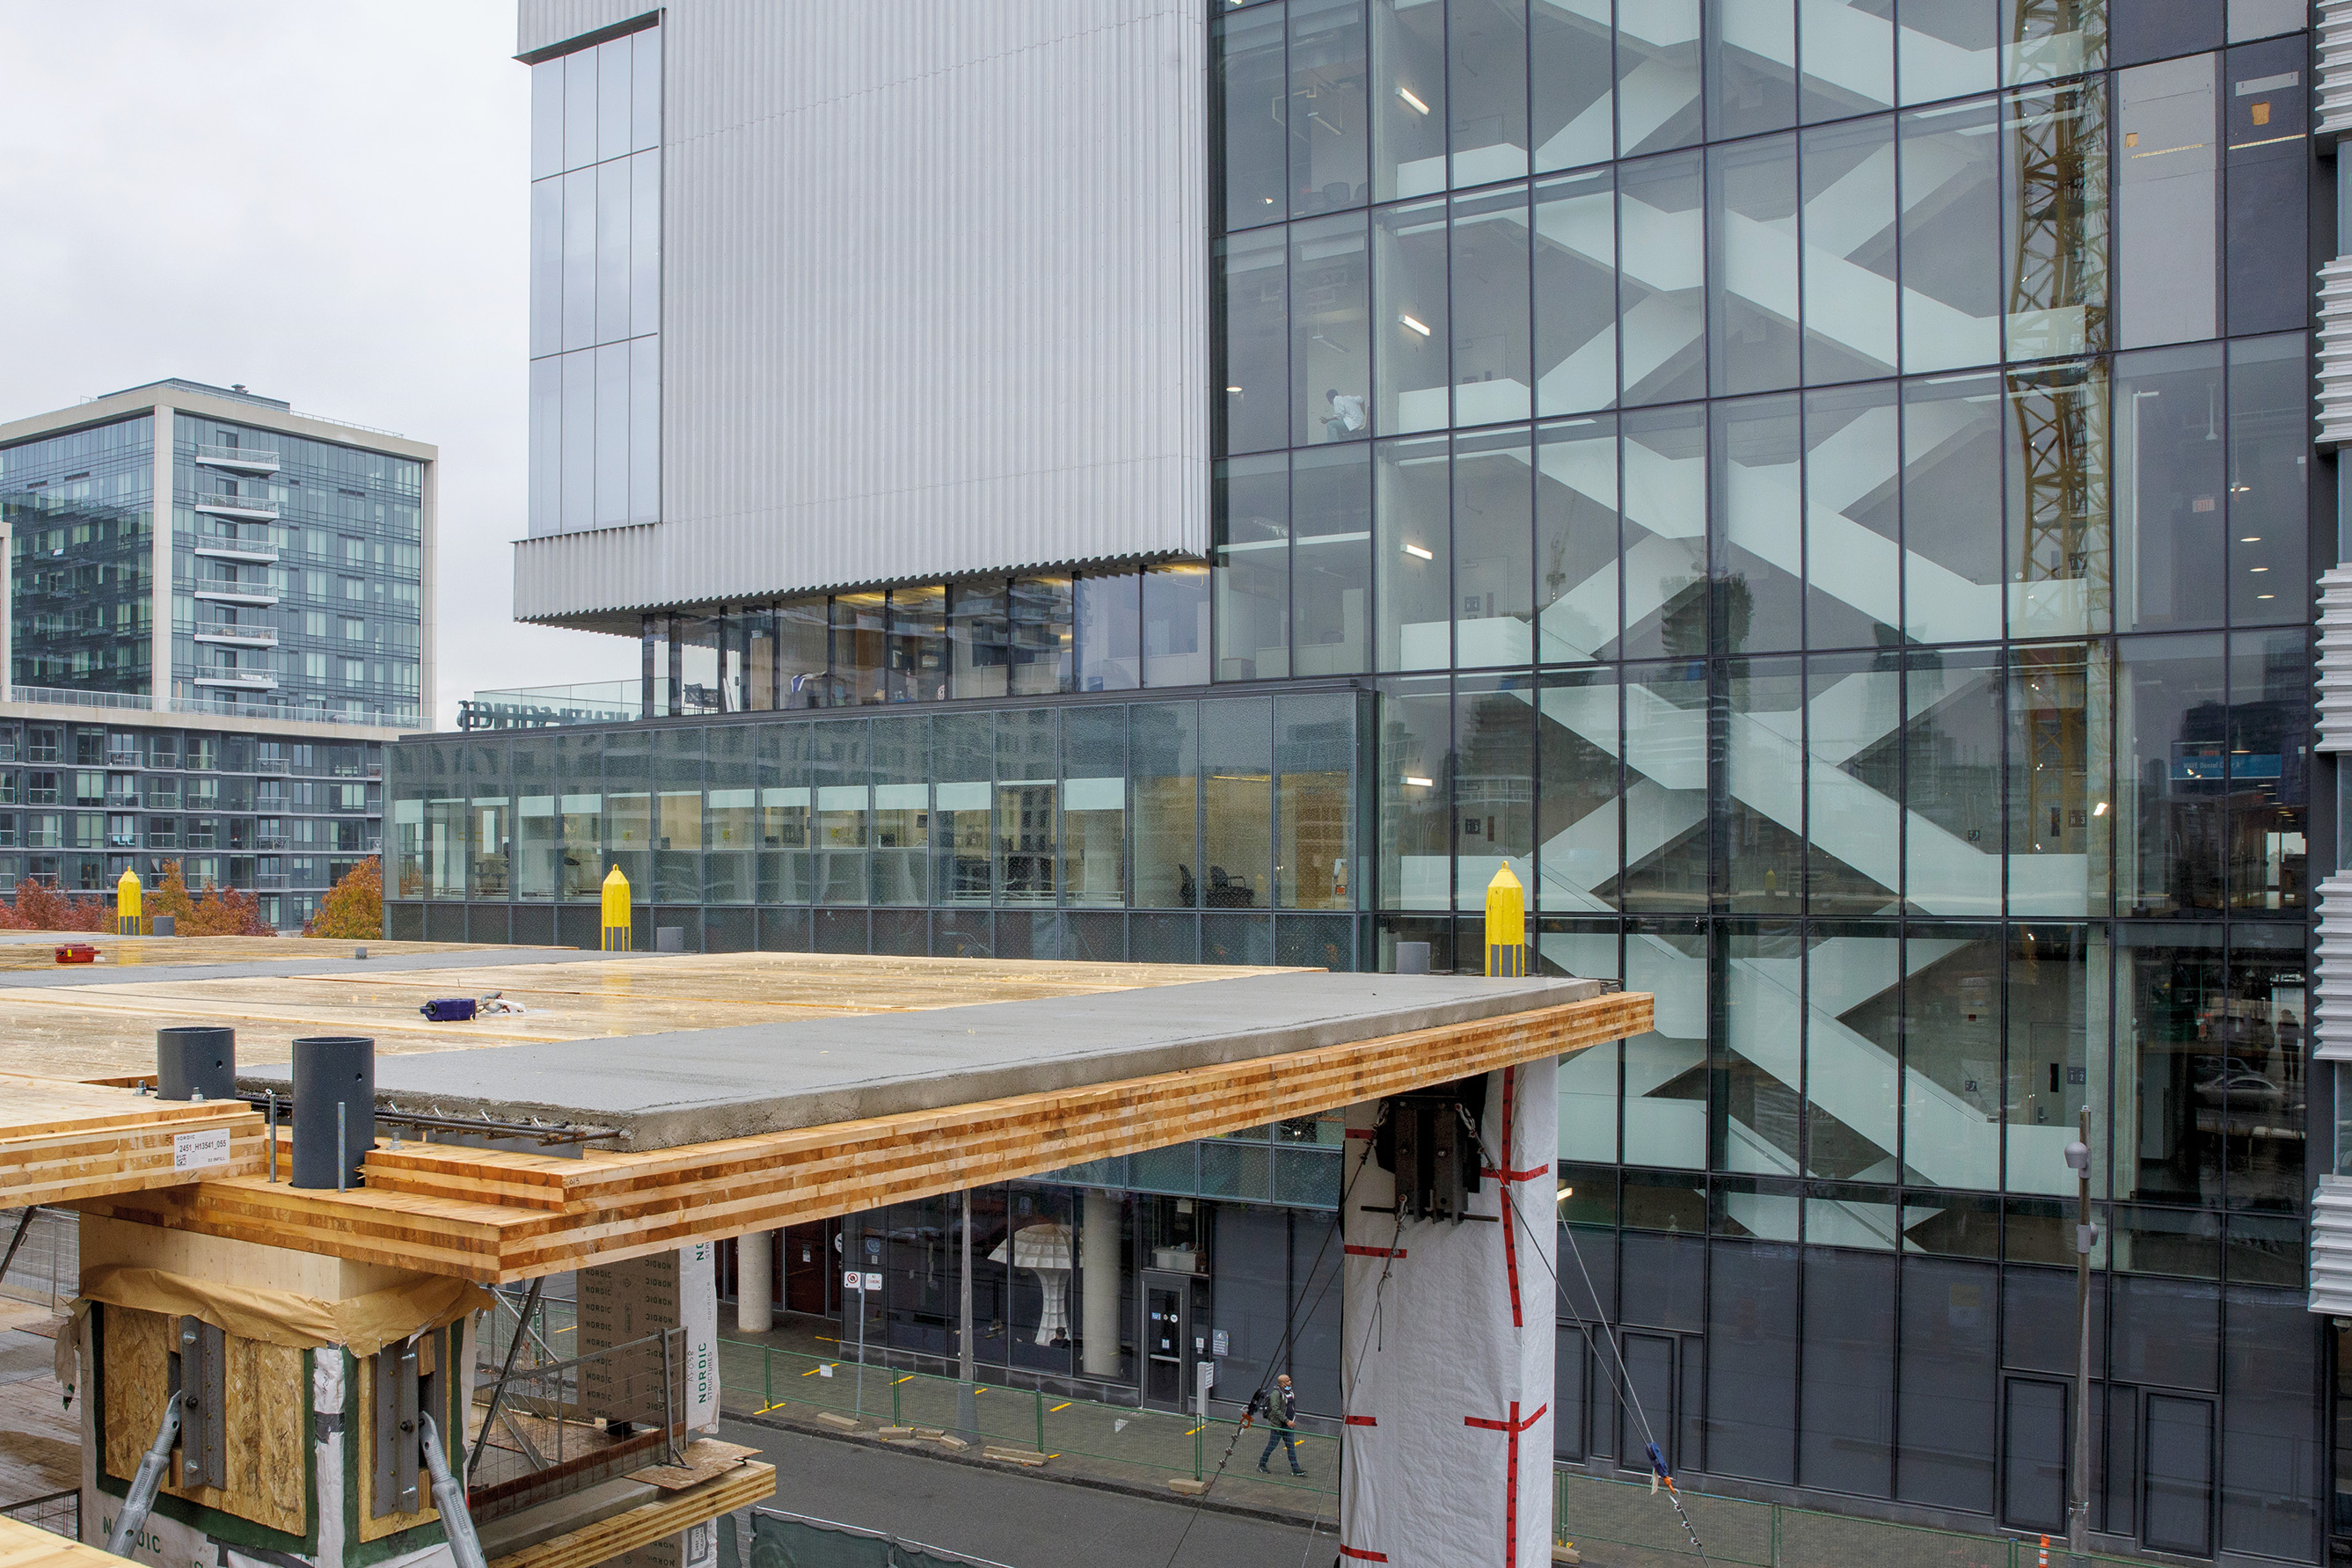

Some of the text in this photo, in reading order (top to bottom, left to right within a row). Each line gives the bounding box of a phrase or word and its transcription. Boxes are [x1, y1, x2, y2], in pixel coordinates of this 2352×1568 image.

[646, 1277, 672, 1288] NORDIC
[585, 1286, 612, 1296] NORDIC
[646, 1295, 673, 1307] NORDIC
[586, 1303, 612, 1314] NORDIC
[646, 1313, 673, 1324] NORDIC
[586, 1321, 612, 1331] NORDIC
[586, 1338, 612, 1348] NORDIC
[586, 1372, 612, 1384] NORDC
[698, 1342, 707, 1404] NORDIC
[587, 1390, 612, 1402] NORDC
[103, 1516, 161, 1554] NDIC
